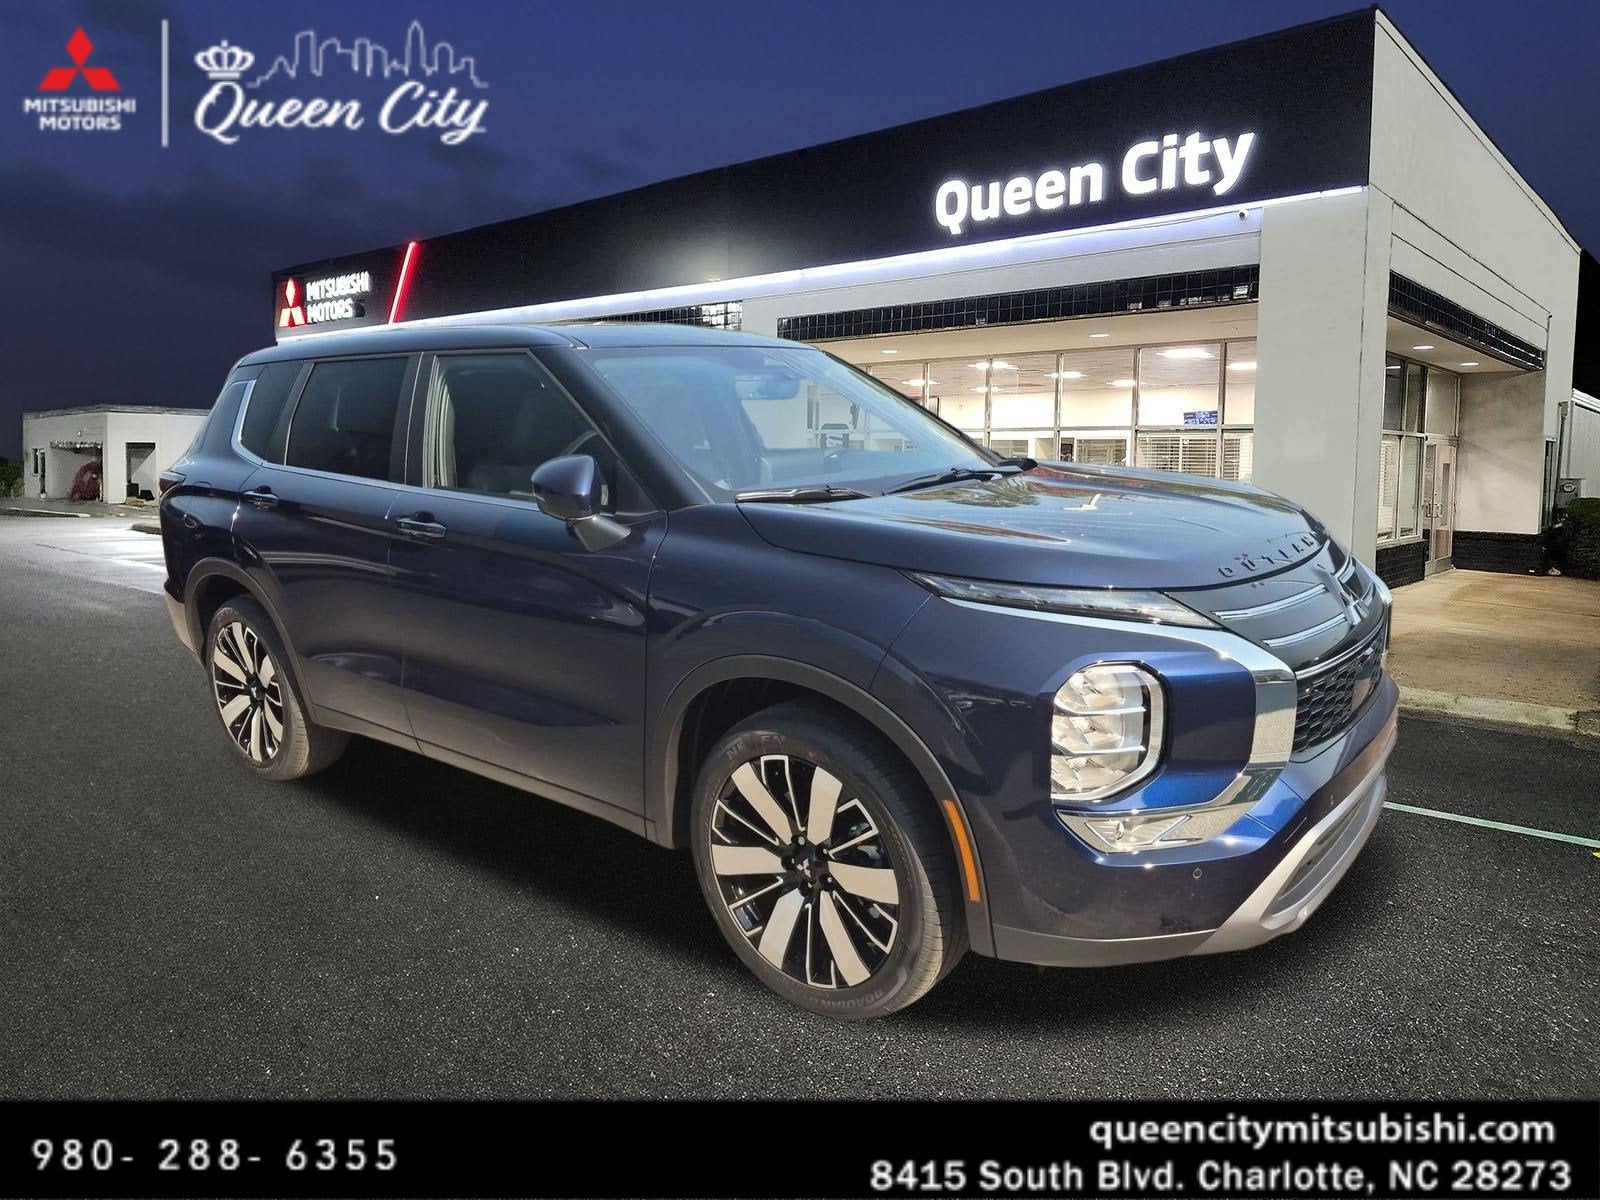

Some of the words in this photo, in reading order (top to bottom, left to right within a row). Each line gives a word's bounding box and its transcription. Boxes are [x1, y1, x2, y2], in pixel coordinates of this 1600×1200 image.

[935, 162, 1104, 235] Queen
[1121, 131, 1256, 196] City
[305, 270, 370, 301] MITSUBISHI
[306, 299, 354, 324] MOTORS
